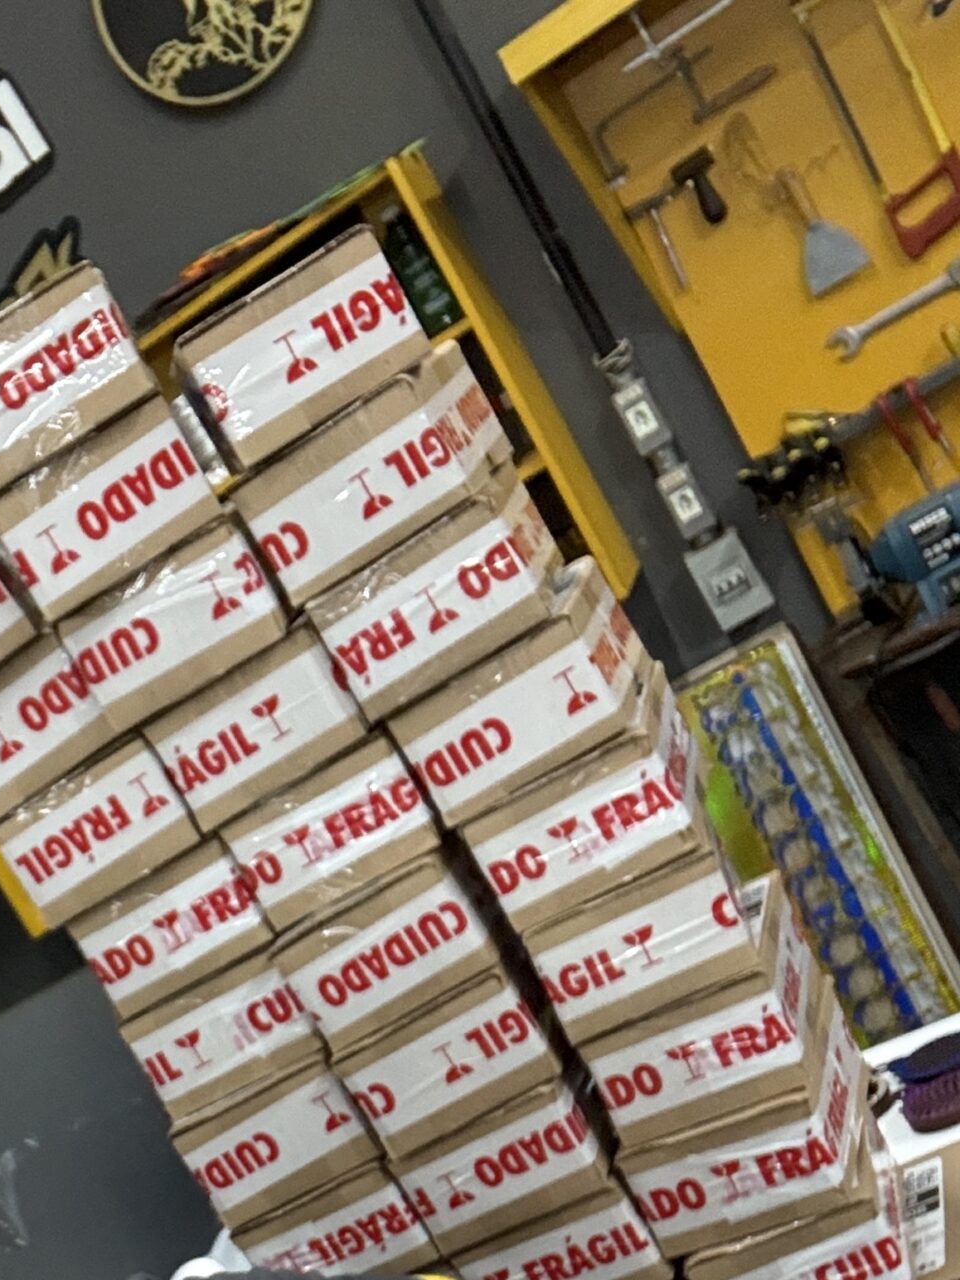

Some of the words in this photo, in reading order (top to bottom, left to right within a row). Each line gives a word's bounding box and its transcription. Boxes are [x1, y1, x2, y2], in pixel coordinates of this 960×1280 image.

[77, 440, 196, 540] IDADO
[17, 796, 131, 883] FRÁGIL
[318, 902, 468, 1007] CUIDADO
[601, 1062, 664, 1109] DO
